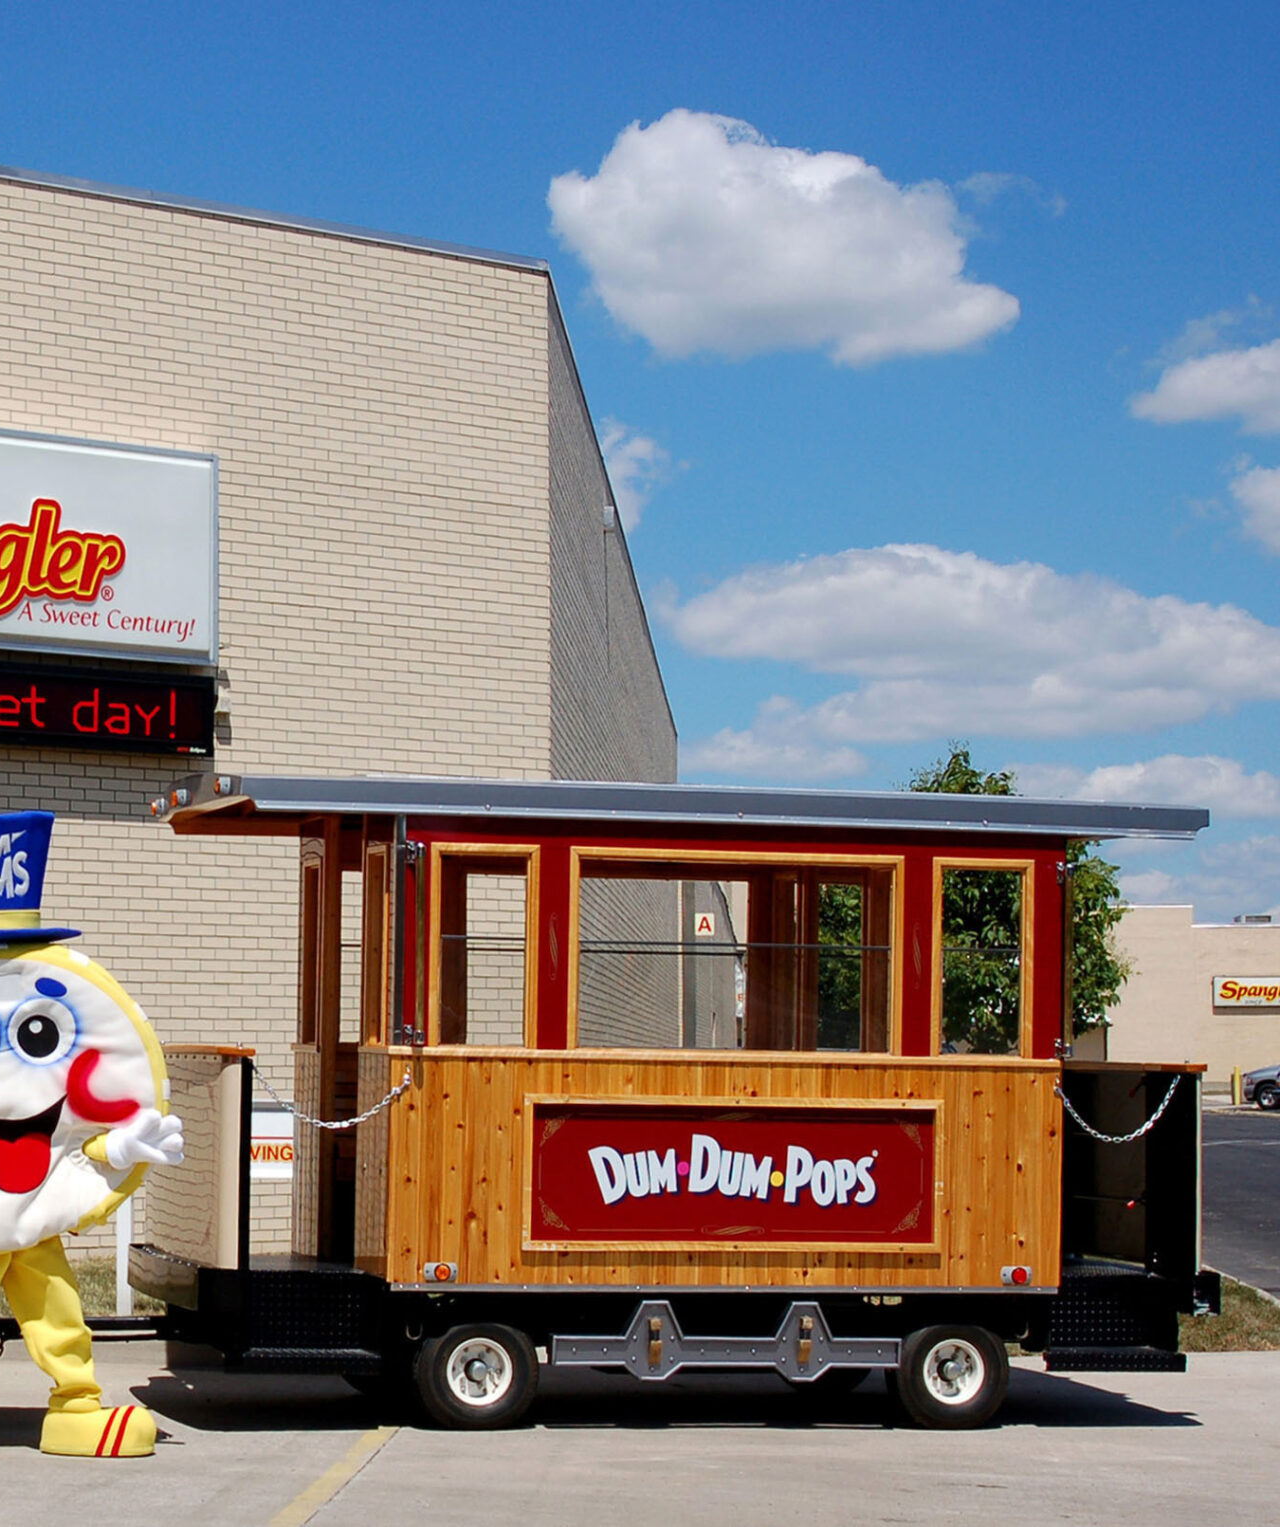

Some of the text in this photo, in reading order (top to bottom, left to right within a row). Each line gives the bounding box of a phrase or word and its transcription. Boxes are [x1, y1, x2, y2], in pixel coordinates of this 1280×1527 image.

[18, 602, 196, 643] A Sweet Century!
[70, 687, 178, 740] day!
[697, 915, 713, 933] A
[1219, 980, 1280, 1002] Spang
